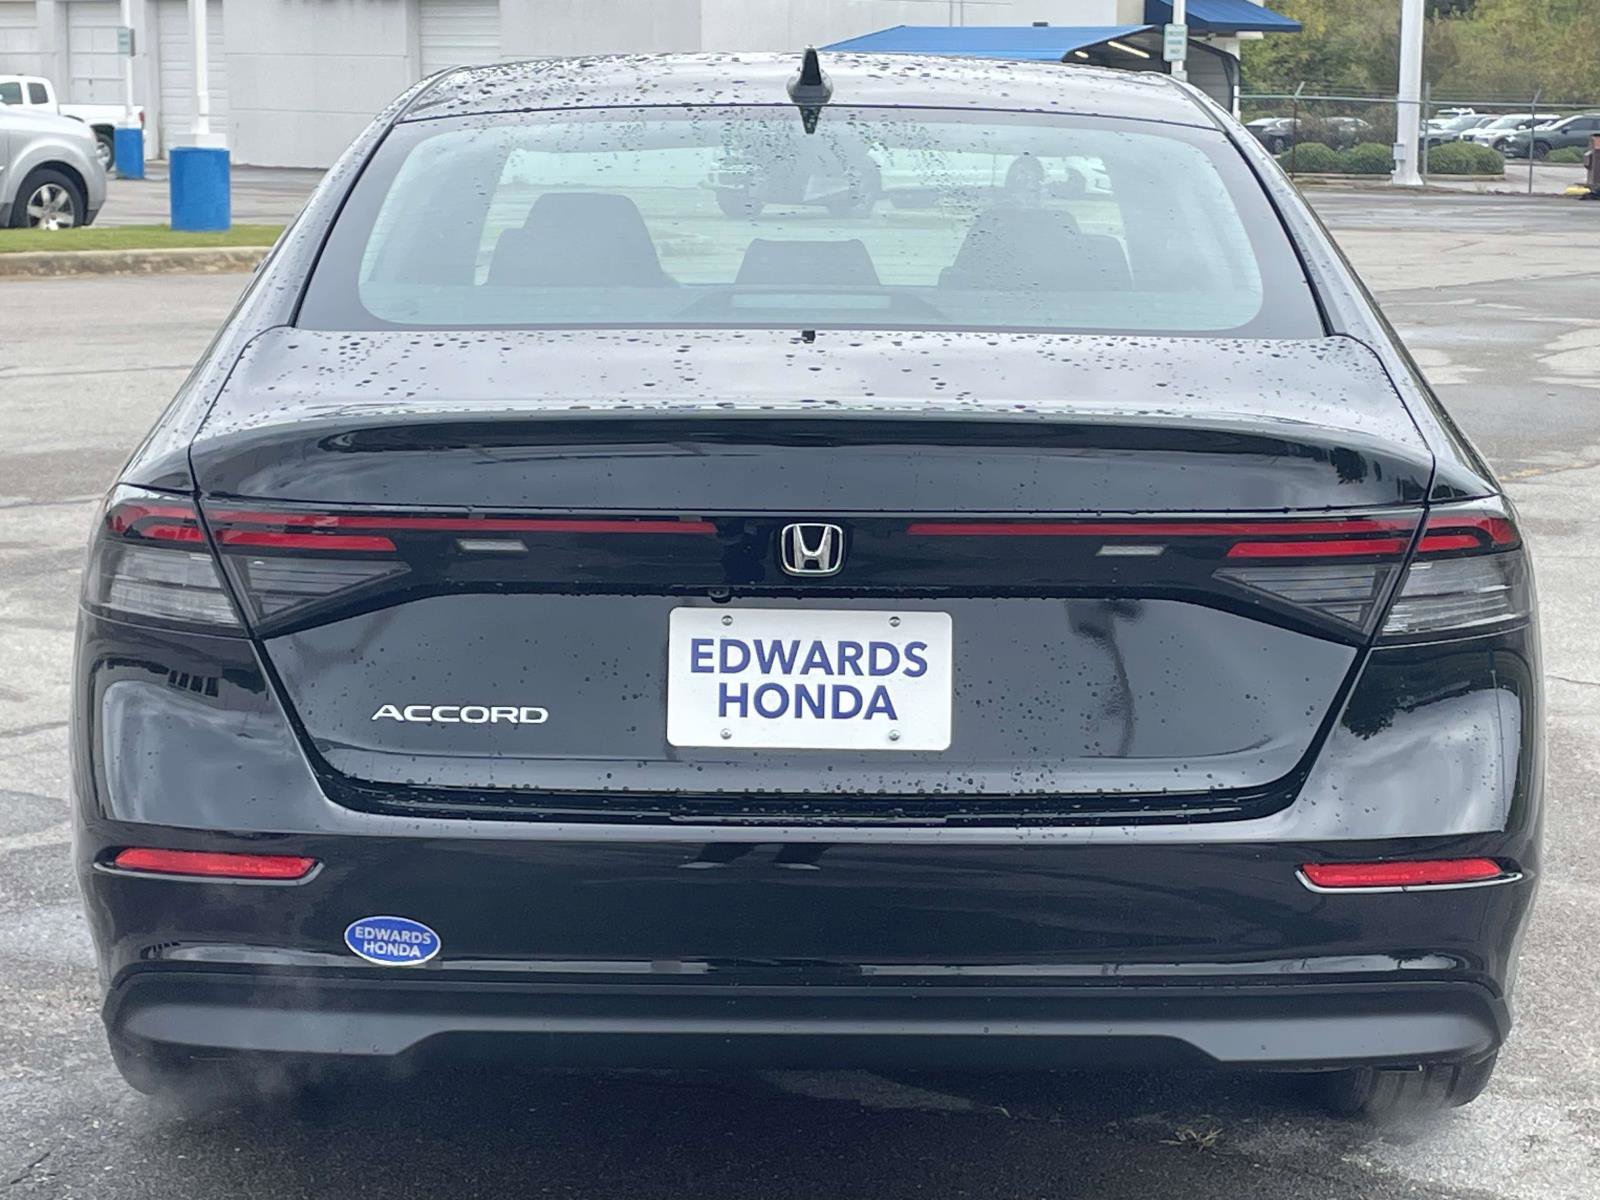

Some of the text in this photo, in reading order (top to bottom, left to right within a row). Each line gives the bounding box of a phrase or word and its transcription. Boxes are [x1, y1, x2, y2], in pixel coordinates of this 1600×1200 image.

[690, 638, 928, 678] EDWARDS
[718, 682, 899, 721] HONDA
[371, 704, 549, 724] ACCORD
[355, 926, 432, 945] EDWARDS
[363, 941, 421, 957] HONDA
